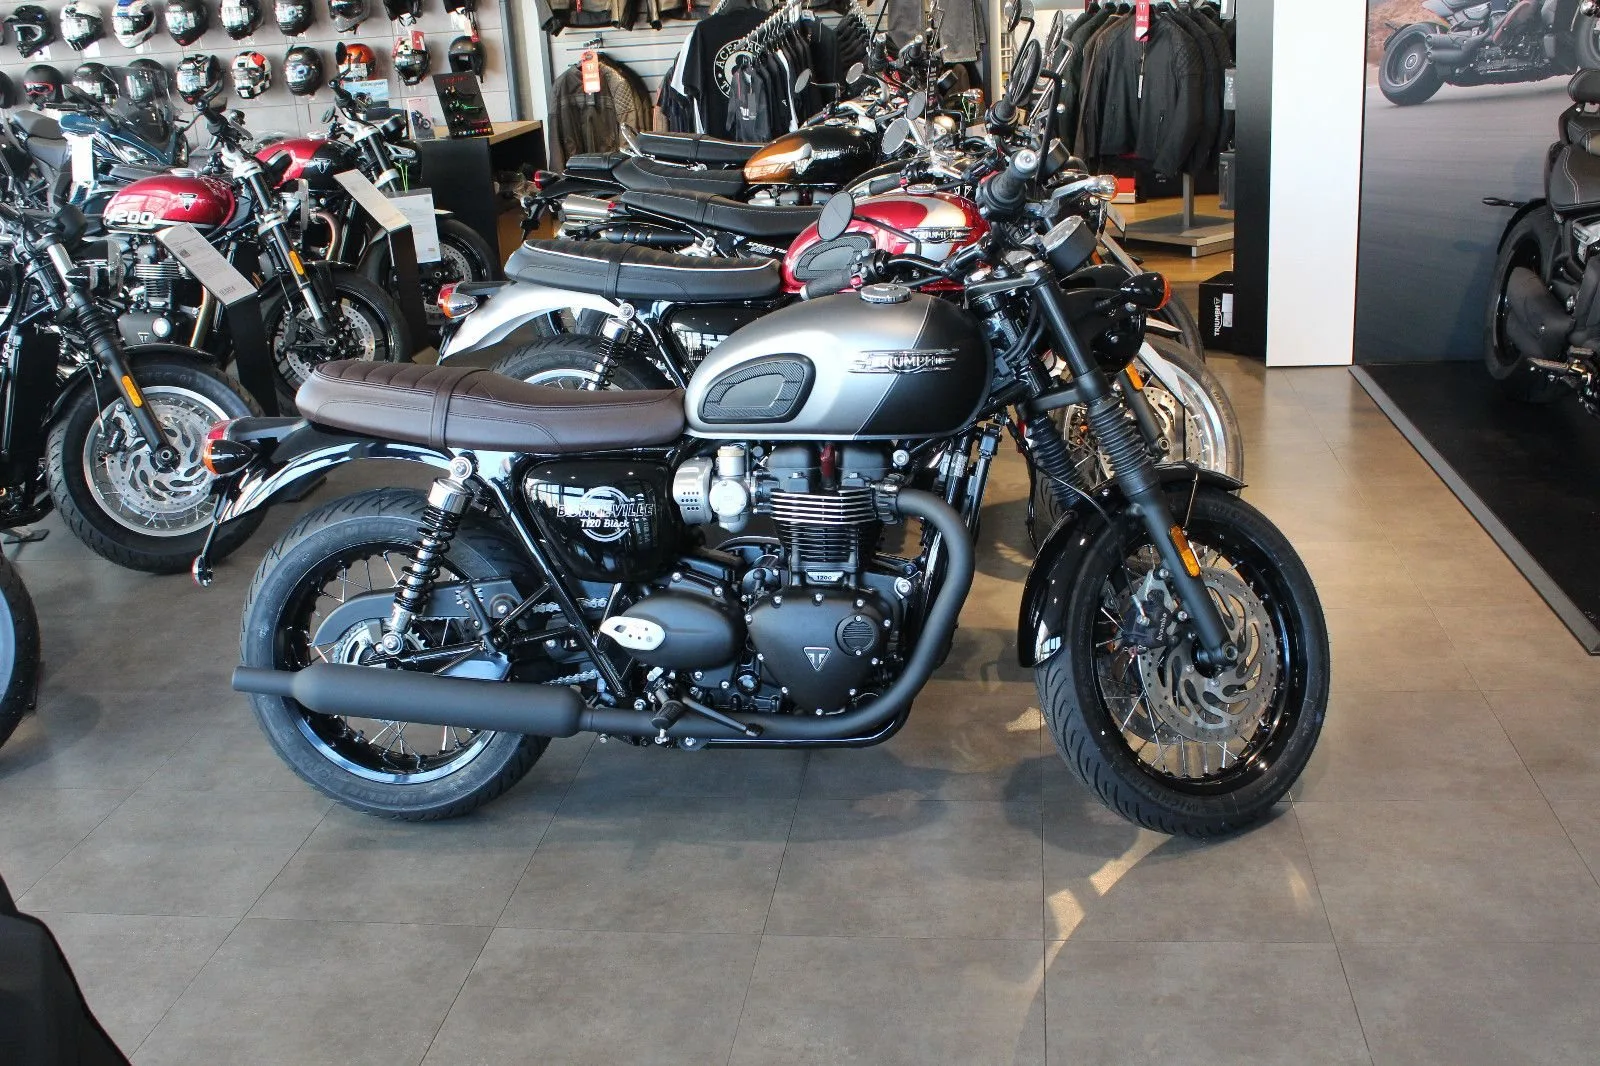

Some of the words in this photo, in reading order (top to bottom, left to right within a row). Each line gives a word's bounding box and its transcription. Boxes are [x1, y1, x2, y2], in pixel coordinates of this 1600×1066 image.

[715, 43, 736, 70] ACE
[1213, 304, 1221, 337] TRIUMPH
[556, 503, 655, 518] BONNEVILLE
[603, 518, 629, 528] Black
[1156, 612, 1168, 641] brembo
